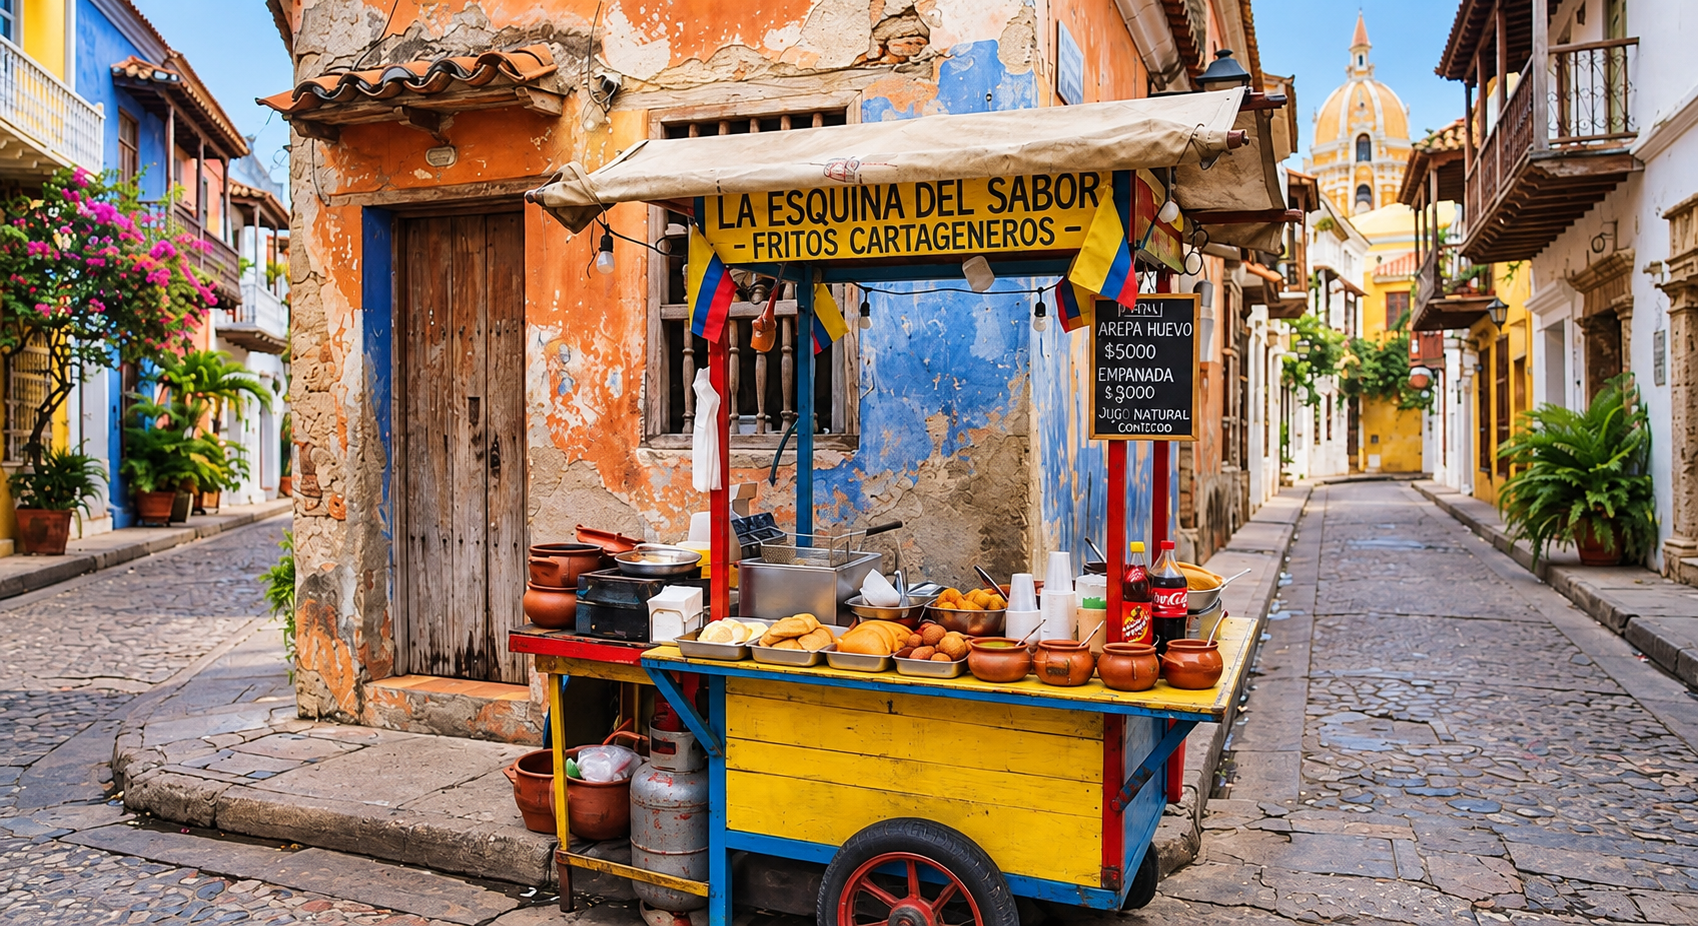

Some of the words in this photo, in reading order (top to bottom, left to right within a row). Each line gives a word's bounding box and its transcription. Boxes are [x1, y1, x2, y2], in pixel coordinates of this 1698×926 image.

[717, 193, 757, 230] LA
[767, 183, 905, 227] ESQUINA
[915, 178, 975, 219] DEL
[986, 171, 1100, 214] SABOR
[752, 228, 839, 260] FRITOS
[849, 216, 1056, 255] CARTAGENEROS
[1098, 321, 1143, 337] AREPA
[1147, 322, 1193, 337] HUEVO
[1104, 341, 1157, 360] $5000
[1098, 367, 1174, 383] EMPANADA
[1098, 407, 1131, 420] JUGO
[1133, 408, 1190, 421] NATURAL
